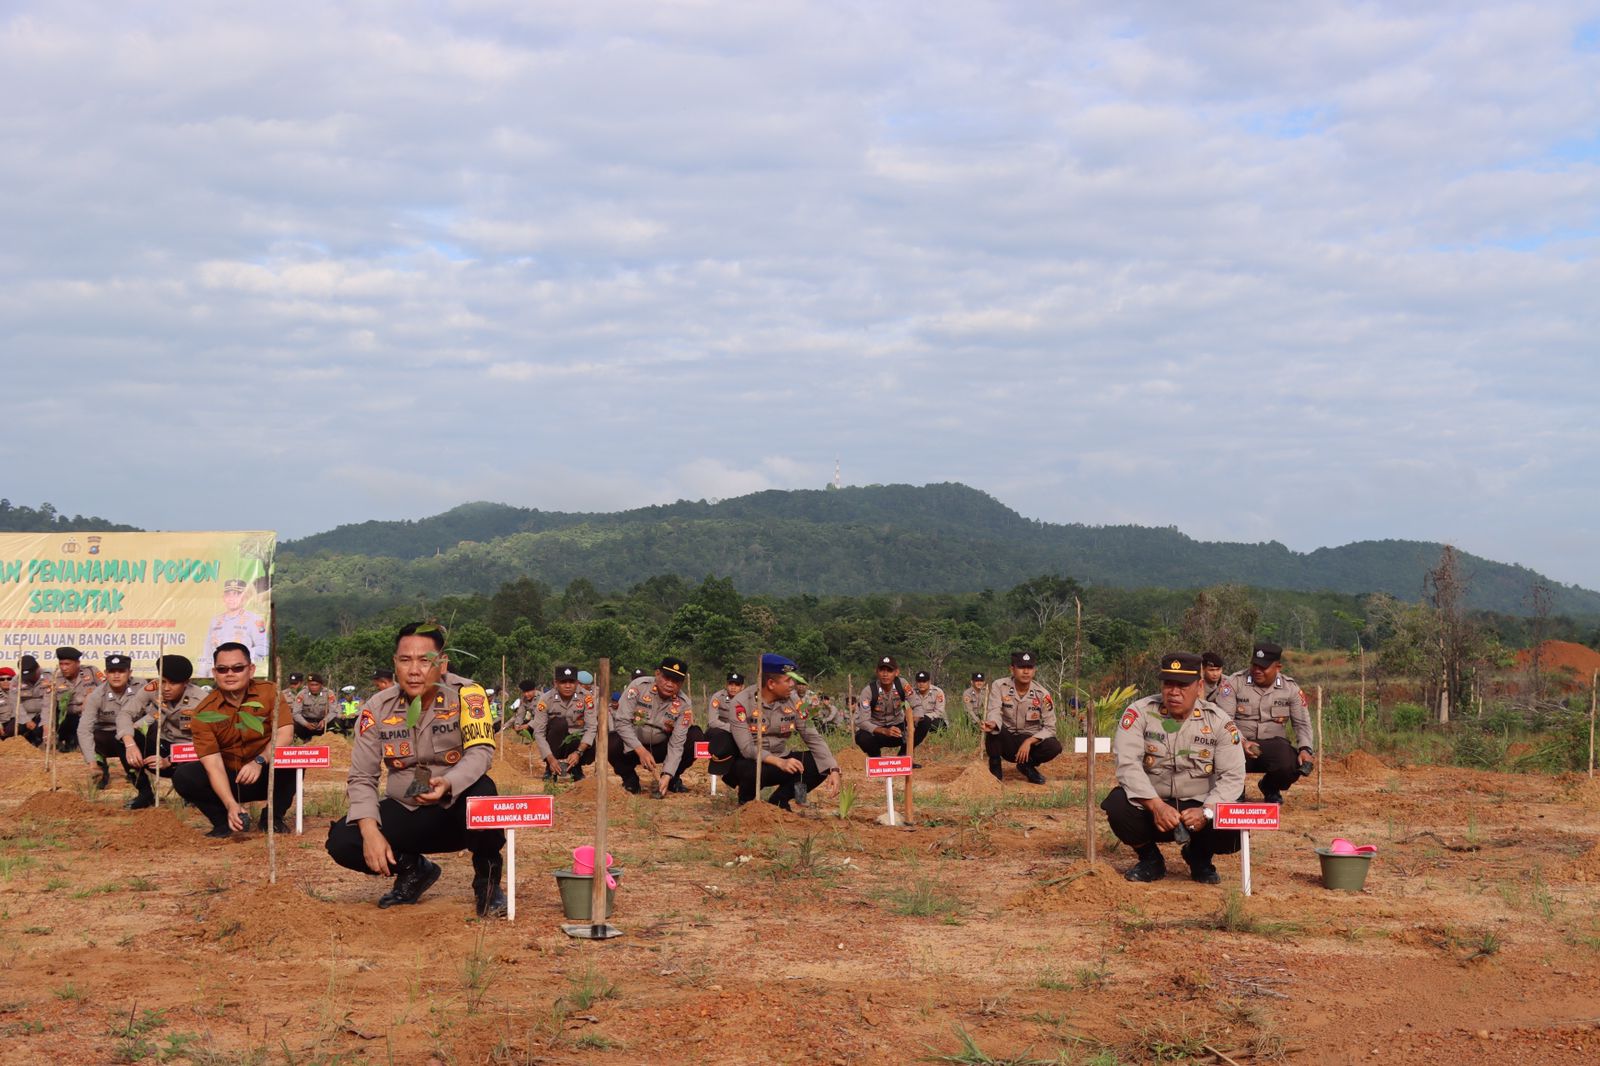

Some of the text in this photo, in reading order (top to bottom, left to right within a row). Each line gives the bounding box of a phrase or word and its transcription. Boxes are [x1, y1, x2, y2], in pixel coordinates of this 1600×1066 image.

[28, 559, 147, 584] PENANAMAN
[152, 558, 221, 584] POHON
[29, 588, 125, 614] SERENTAK
[4, 632, 186, 646] KEPULAUAN BANGKA BELITUNG
[431, 721, 460, 735] POLR
[493, 802, 528, 811] KABAG OPS
[471, 813, 550, 823] POLRES BANGKA SELATAN
